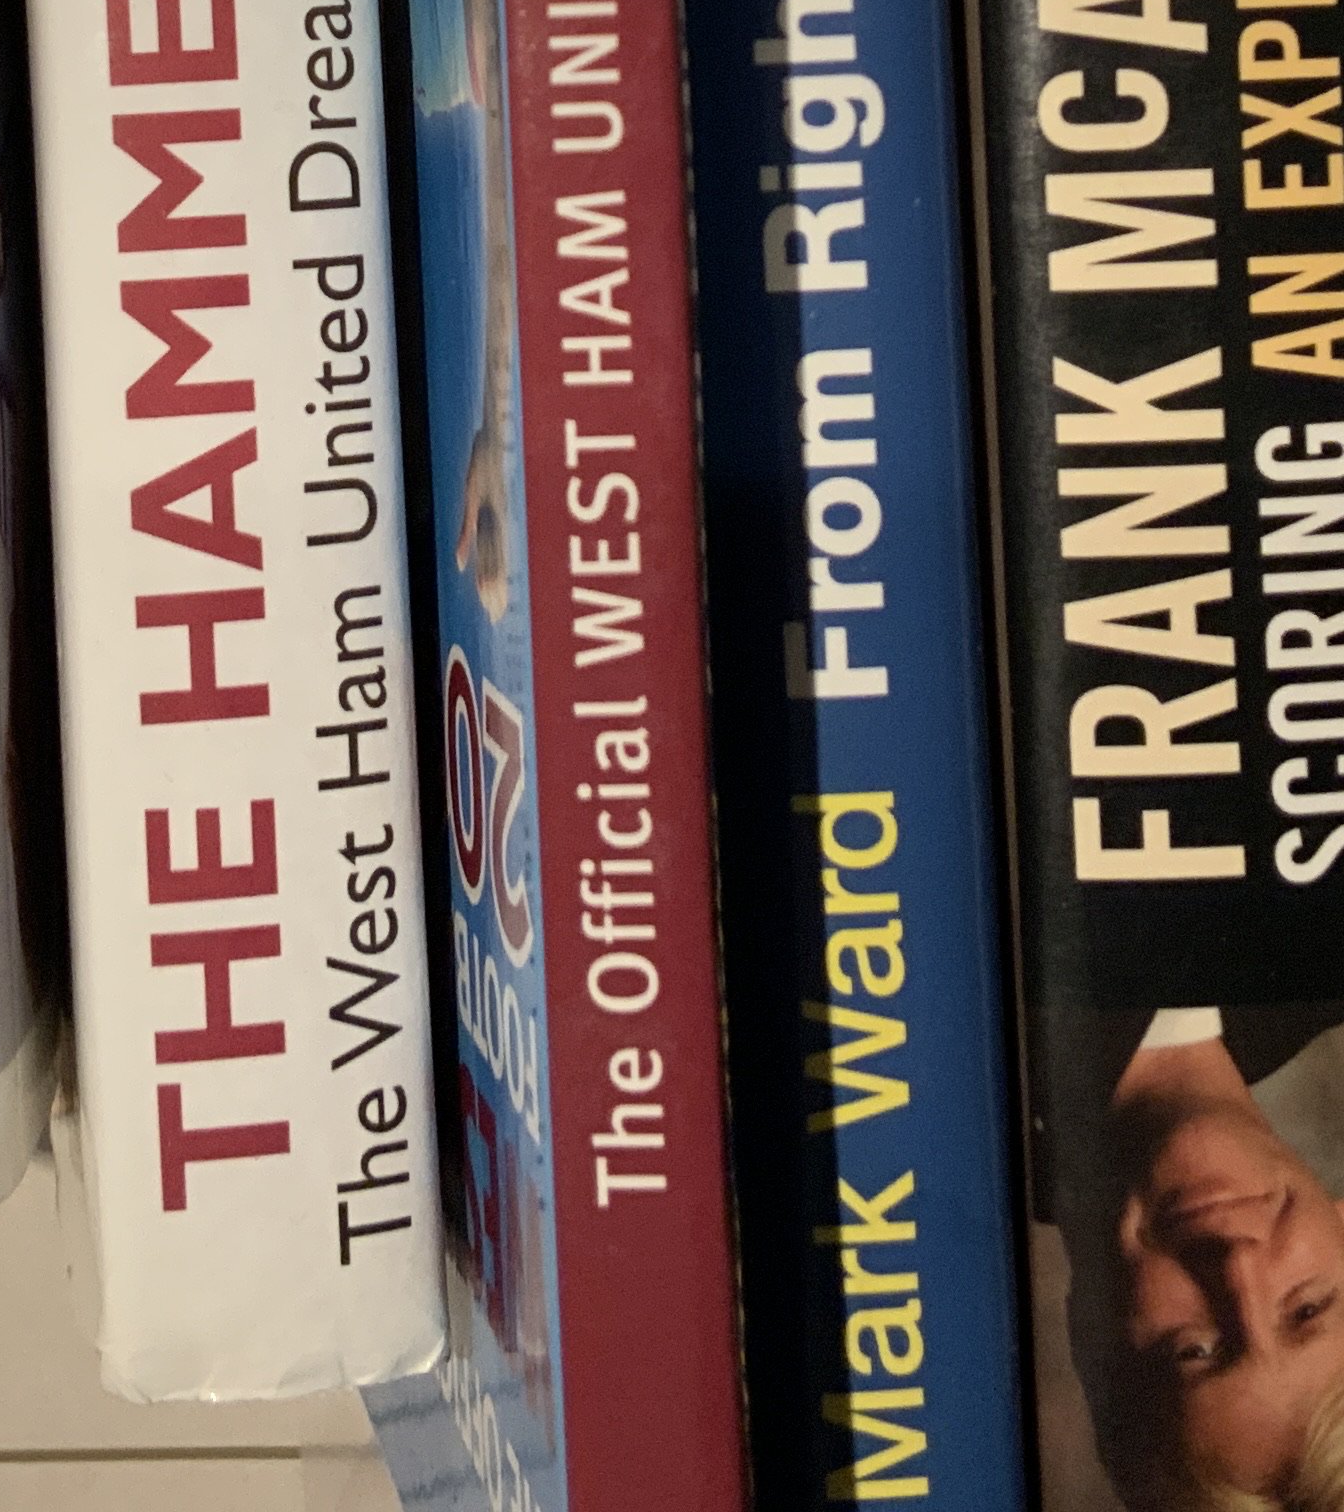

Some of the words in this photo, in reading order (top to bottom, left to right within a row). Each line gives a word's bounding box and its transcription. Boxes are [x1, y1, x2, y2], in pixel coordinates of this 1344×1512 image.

[293, 255, 377, 548] United
[556, 188, 633, 386] HAM
[564, 419, 646, 669] WEST
[783, 346, 888, 699] From
[1053, 347, 1247, 881] FRANK
[315, 585, 391, 793] Ham
[325, 822, 403, 1071] West
[575, 694, 659, 1015] Official
[792, 789, 911, 1134] Ward
[145, 798, 291, 1212] THE
[596, 1048, 667, 1209] The
[337, 1085, 412, 1266] The
[811, 1169, 929, 1501] Mark
